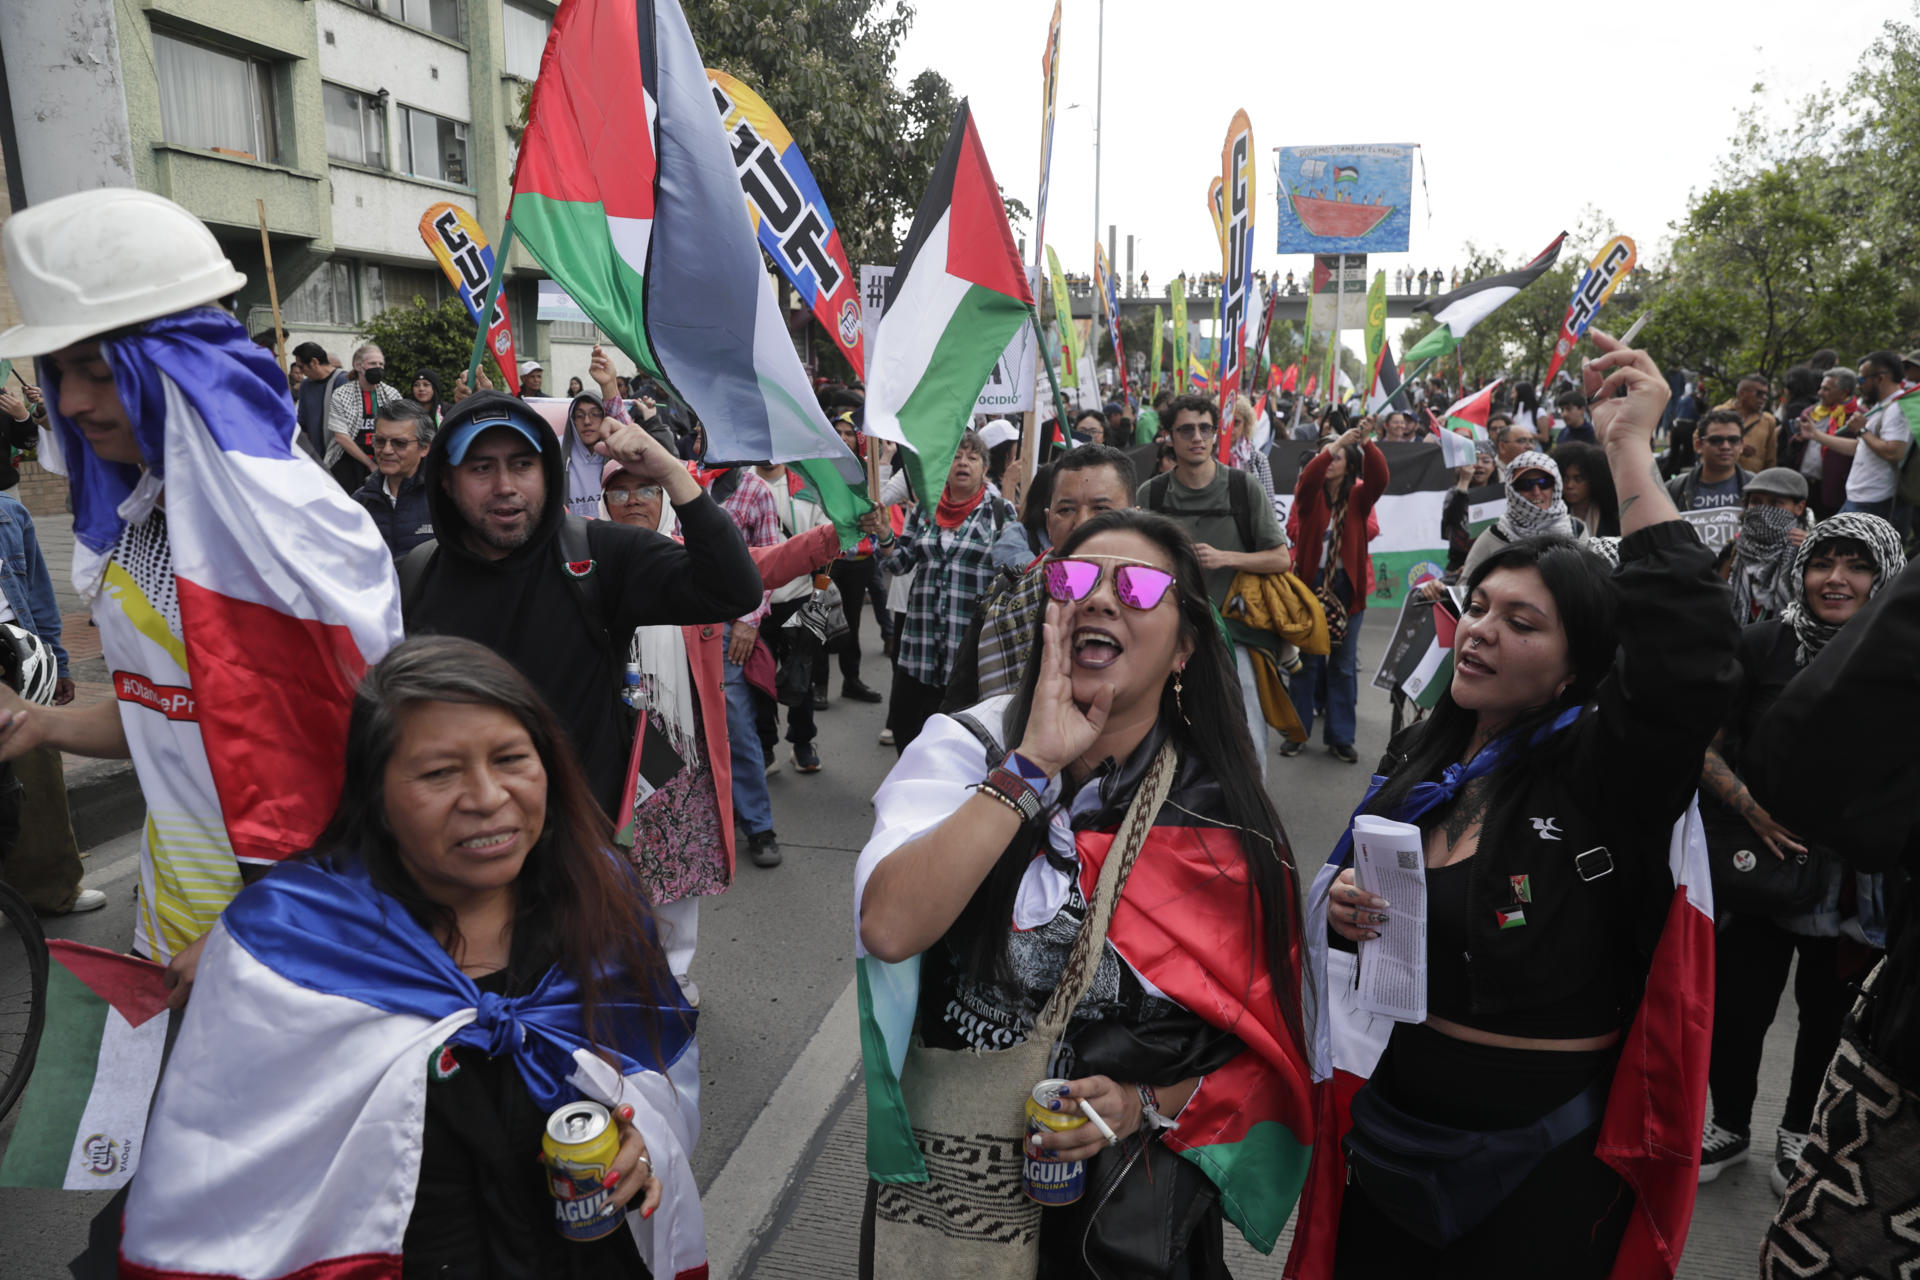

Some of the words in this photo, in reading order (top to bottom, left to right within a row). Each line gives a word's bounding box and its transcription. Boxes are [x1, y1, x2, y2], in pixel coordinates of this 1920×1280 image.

[434, 209, 504, 328] CUT
[1225, 131, 1249, 378] CUT
[1566, 242, 1630, 335] CUT
[567, 494, 601, 505] AMAZ
[963, 992, 1013, 1025] PRESIDENTE
[1013, 1015, 1021, 1032] A
[119, 1138, 132, 1173] APOYA
[1031, 1181, 1069, 1191] ORIGINAL
